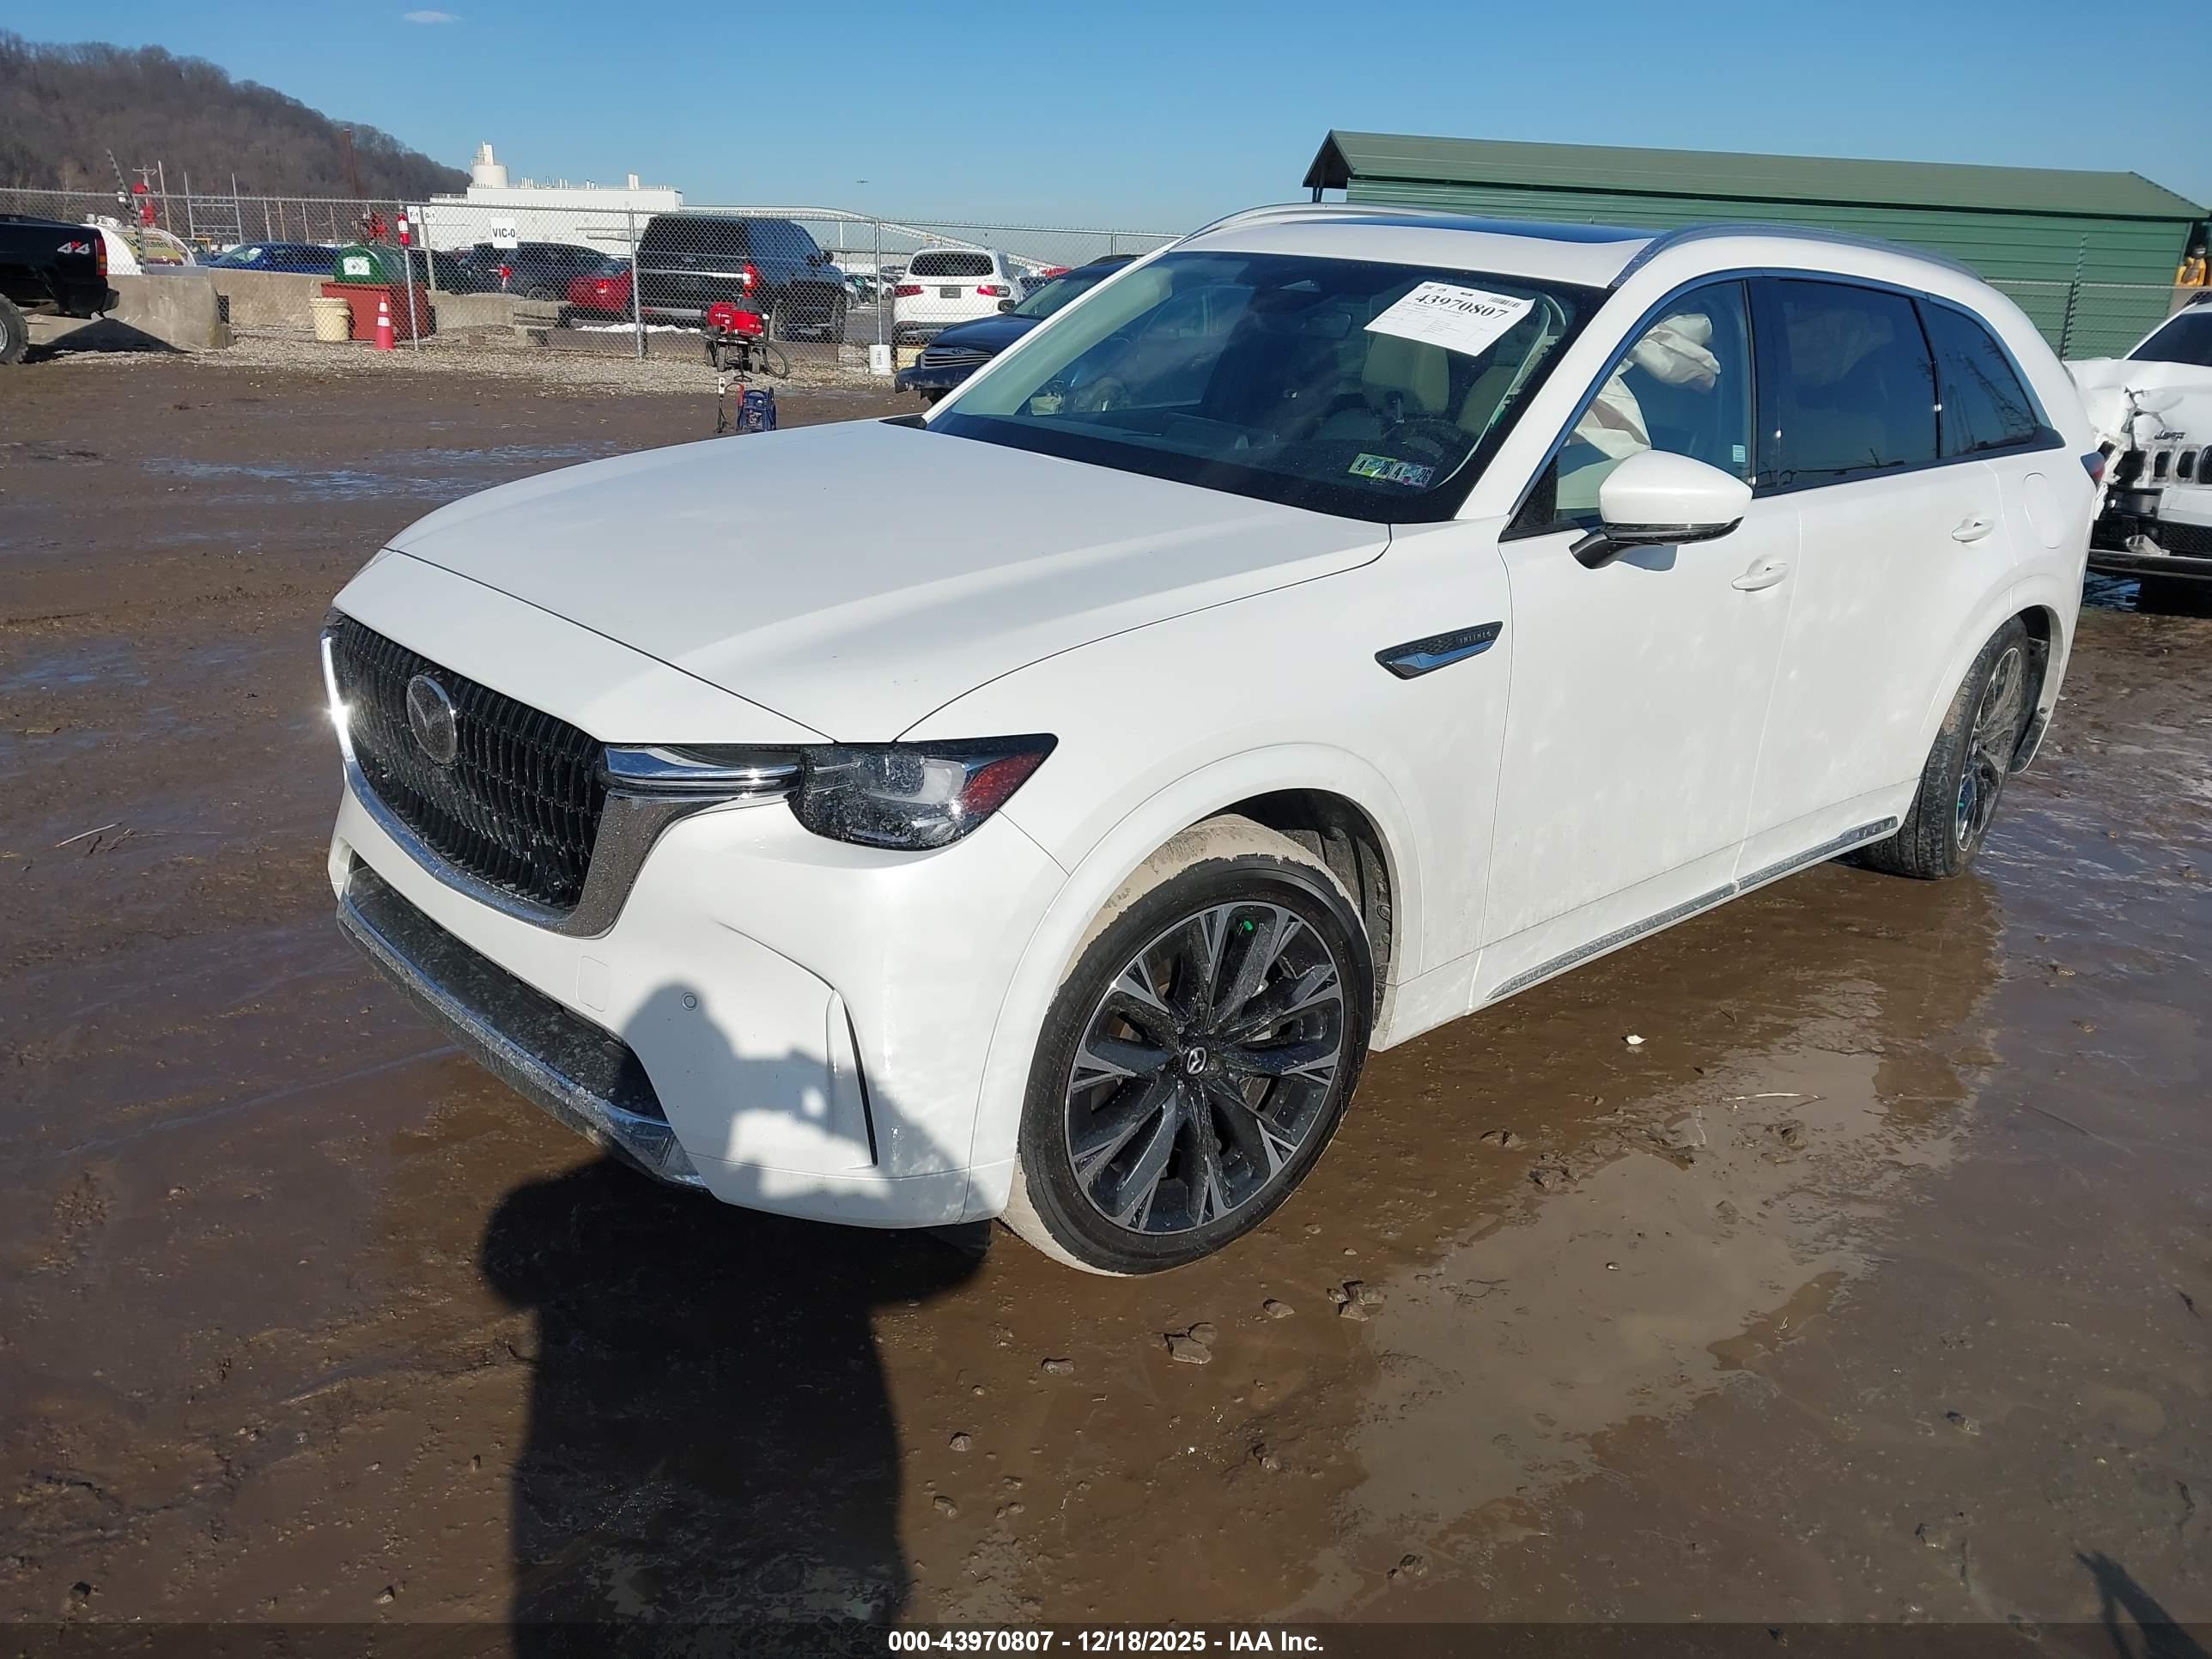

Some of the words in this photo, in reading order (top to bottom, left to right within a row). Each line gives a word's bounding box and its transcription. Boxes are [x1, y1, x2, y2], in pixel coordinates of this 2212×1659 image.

[1414, 293, 1510, 319] 43970807
[2154, 429, 2186, 441] Jeep
[1356, 459, 1367, 471] 4
[1393, 466, 1403, 478] 4
